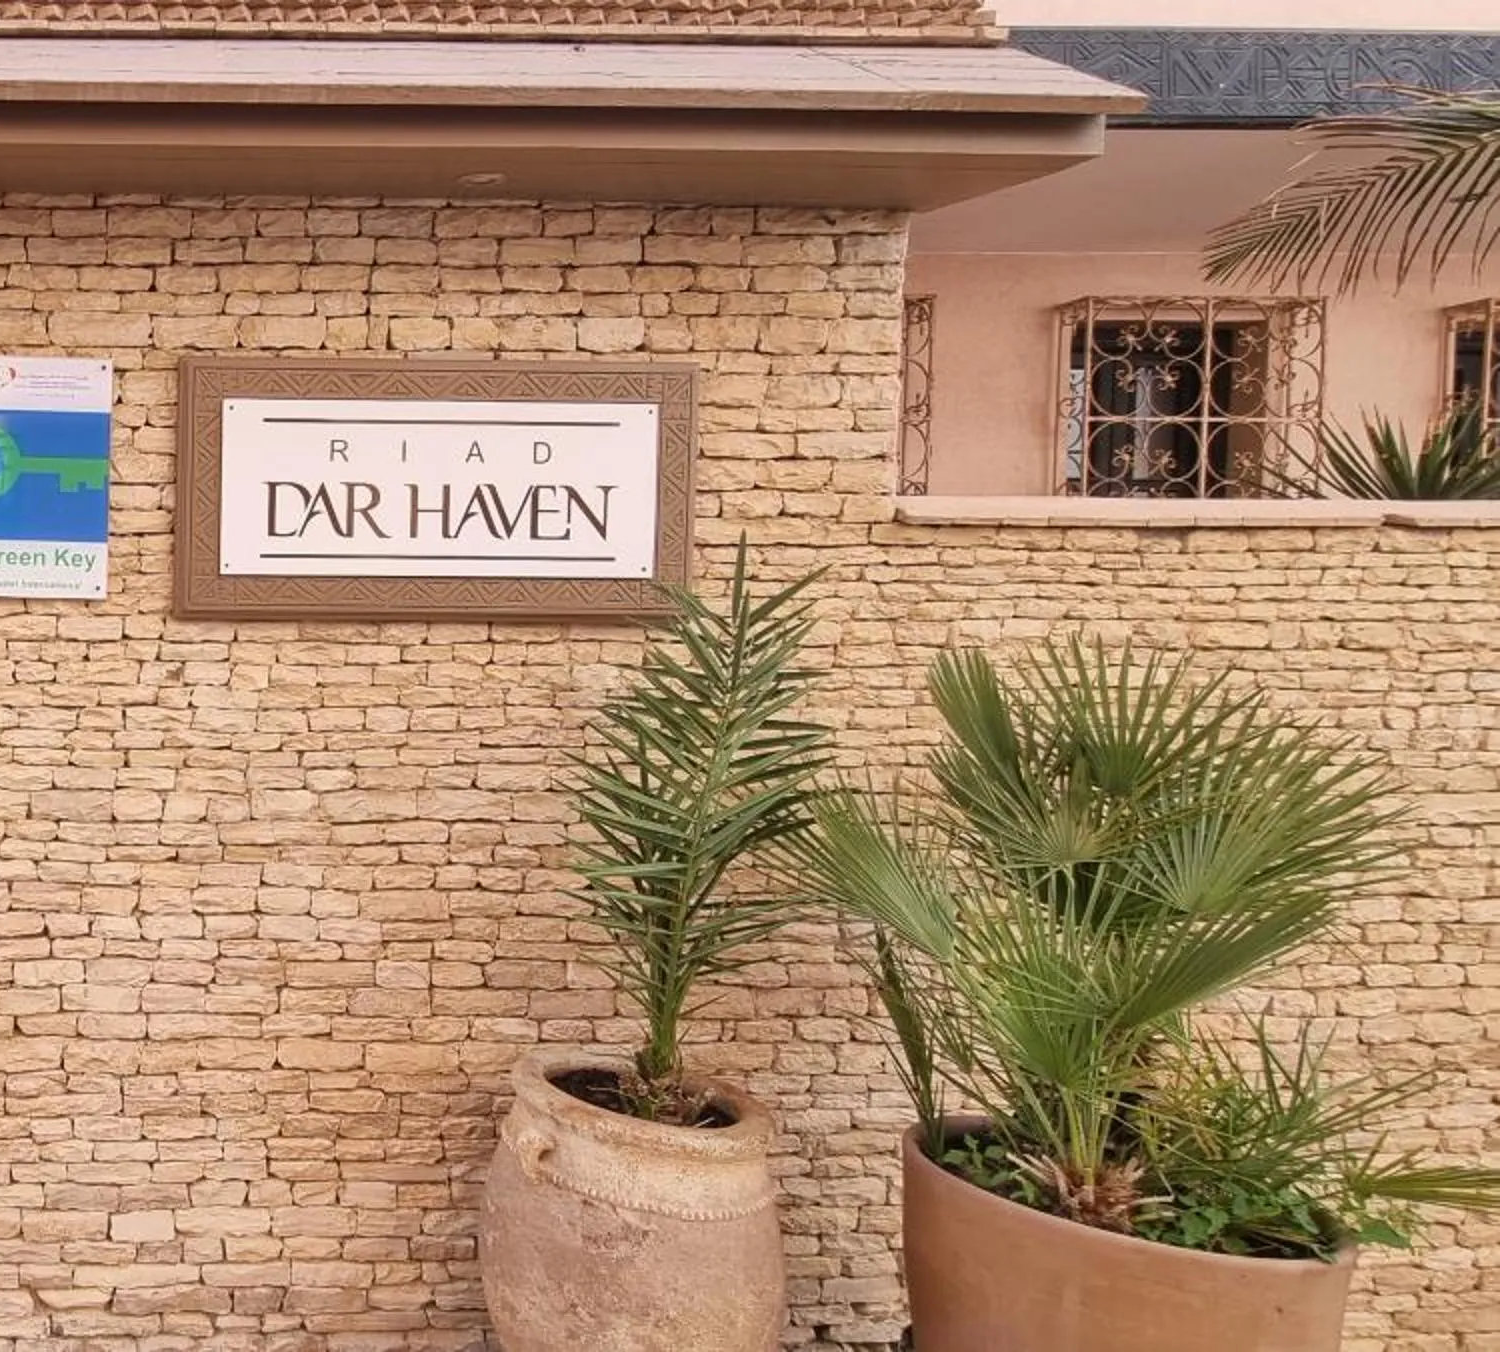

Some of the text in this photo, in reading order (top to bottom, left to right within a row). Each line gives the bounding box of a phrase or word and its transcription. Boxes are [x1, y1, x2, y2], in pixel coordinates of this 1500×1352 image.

[330, 439, 553, 465] RIAD
[262, 481, 619, 541] DAR HAVEN
[55, 548, 96, 572] Key
